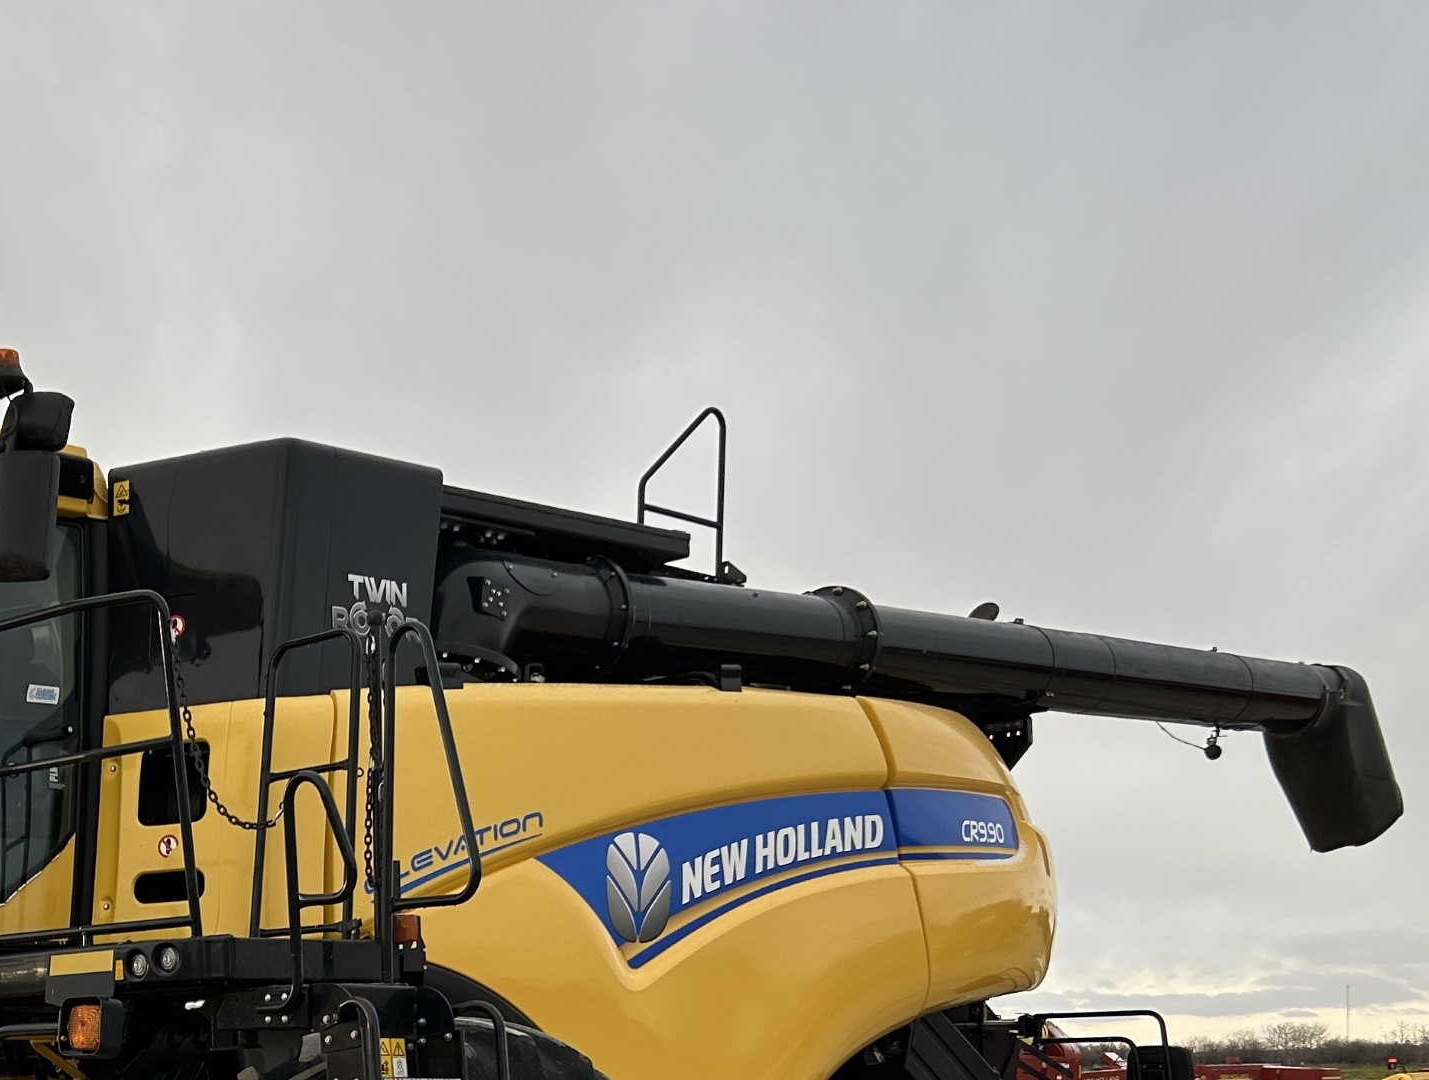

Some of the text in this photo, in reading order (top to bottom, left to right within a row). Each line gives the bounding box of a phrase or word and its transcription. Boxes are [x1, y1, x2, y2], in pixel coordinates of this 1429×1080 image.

[332, 600, 421, 643] ROO
[347, 573, 408, 608] TWIN
[365, 811, 544, 894] EVATION
[681, 813, 1005, 905] NEW HOLLAND CR9.90
